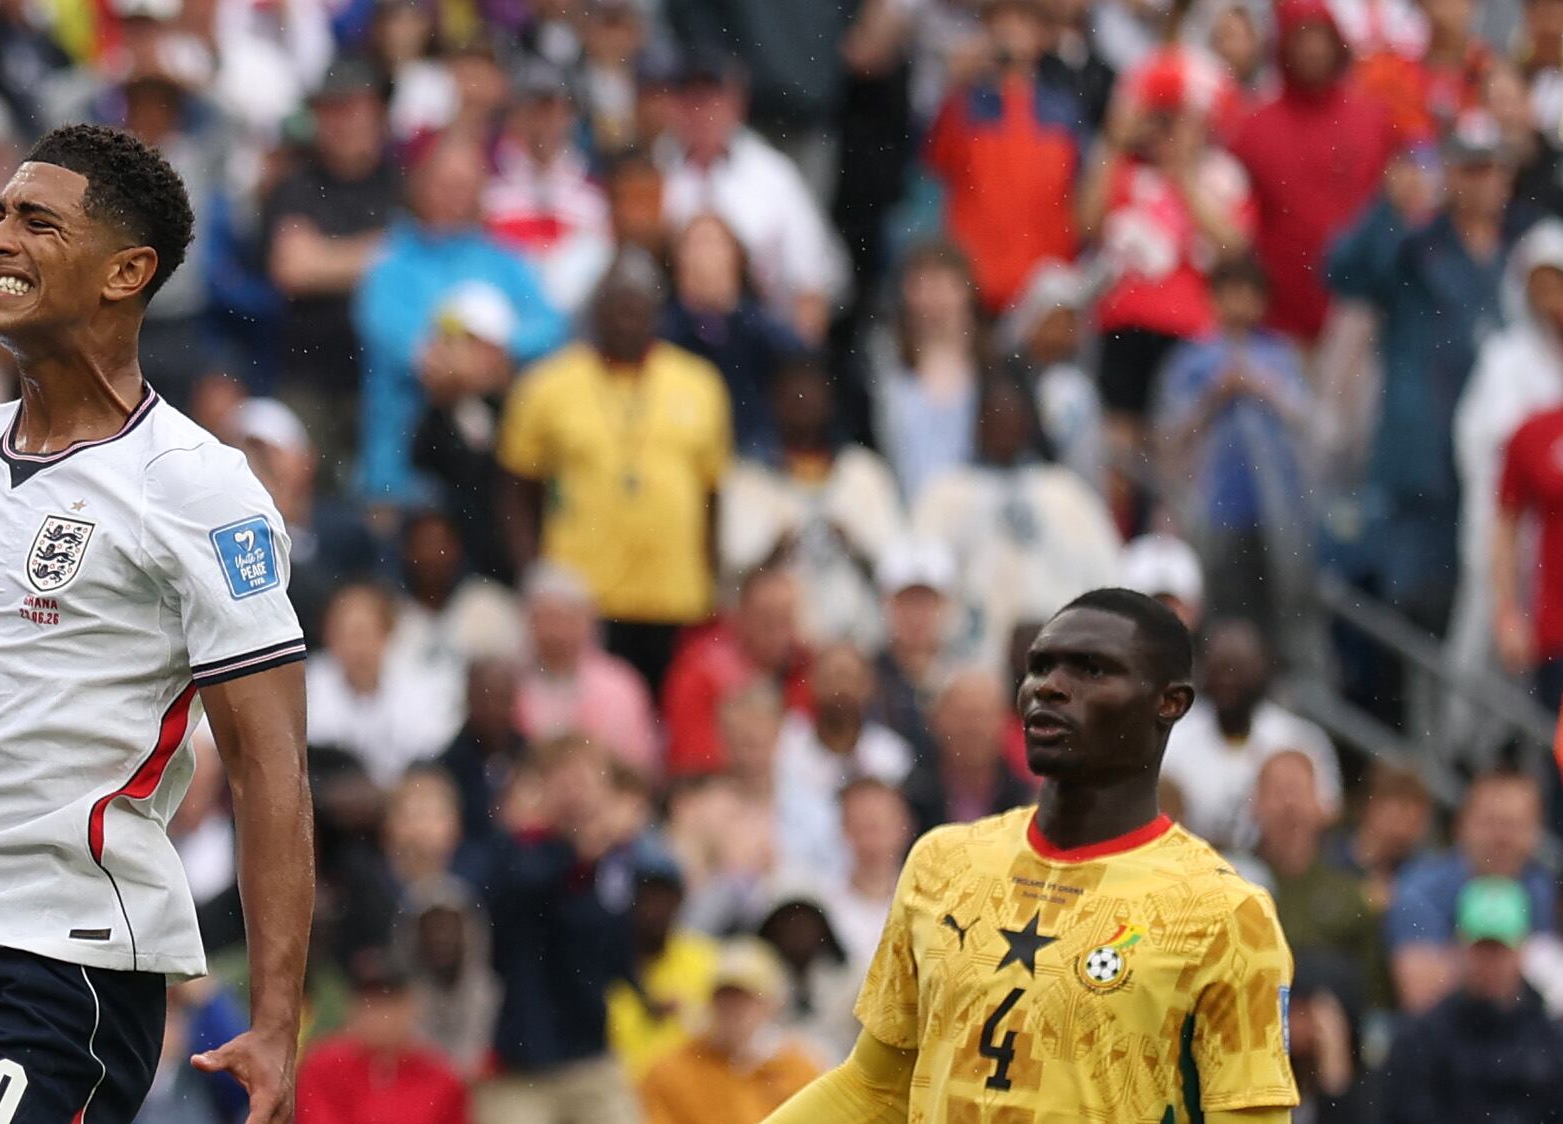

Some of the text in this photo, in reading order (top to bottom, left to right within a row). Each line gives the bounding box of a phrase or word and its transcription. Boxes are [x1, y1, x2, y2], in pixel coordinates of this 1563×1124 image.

[240, 561, 267, 581] PEACE
[250, 577, 266, 588] FIFA
[978, 987, 1026, 1092] 4
